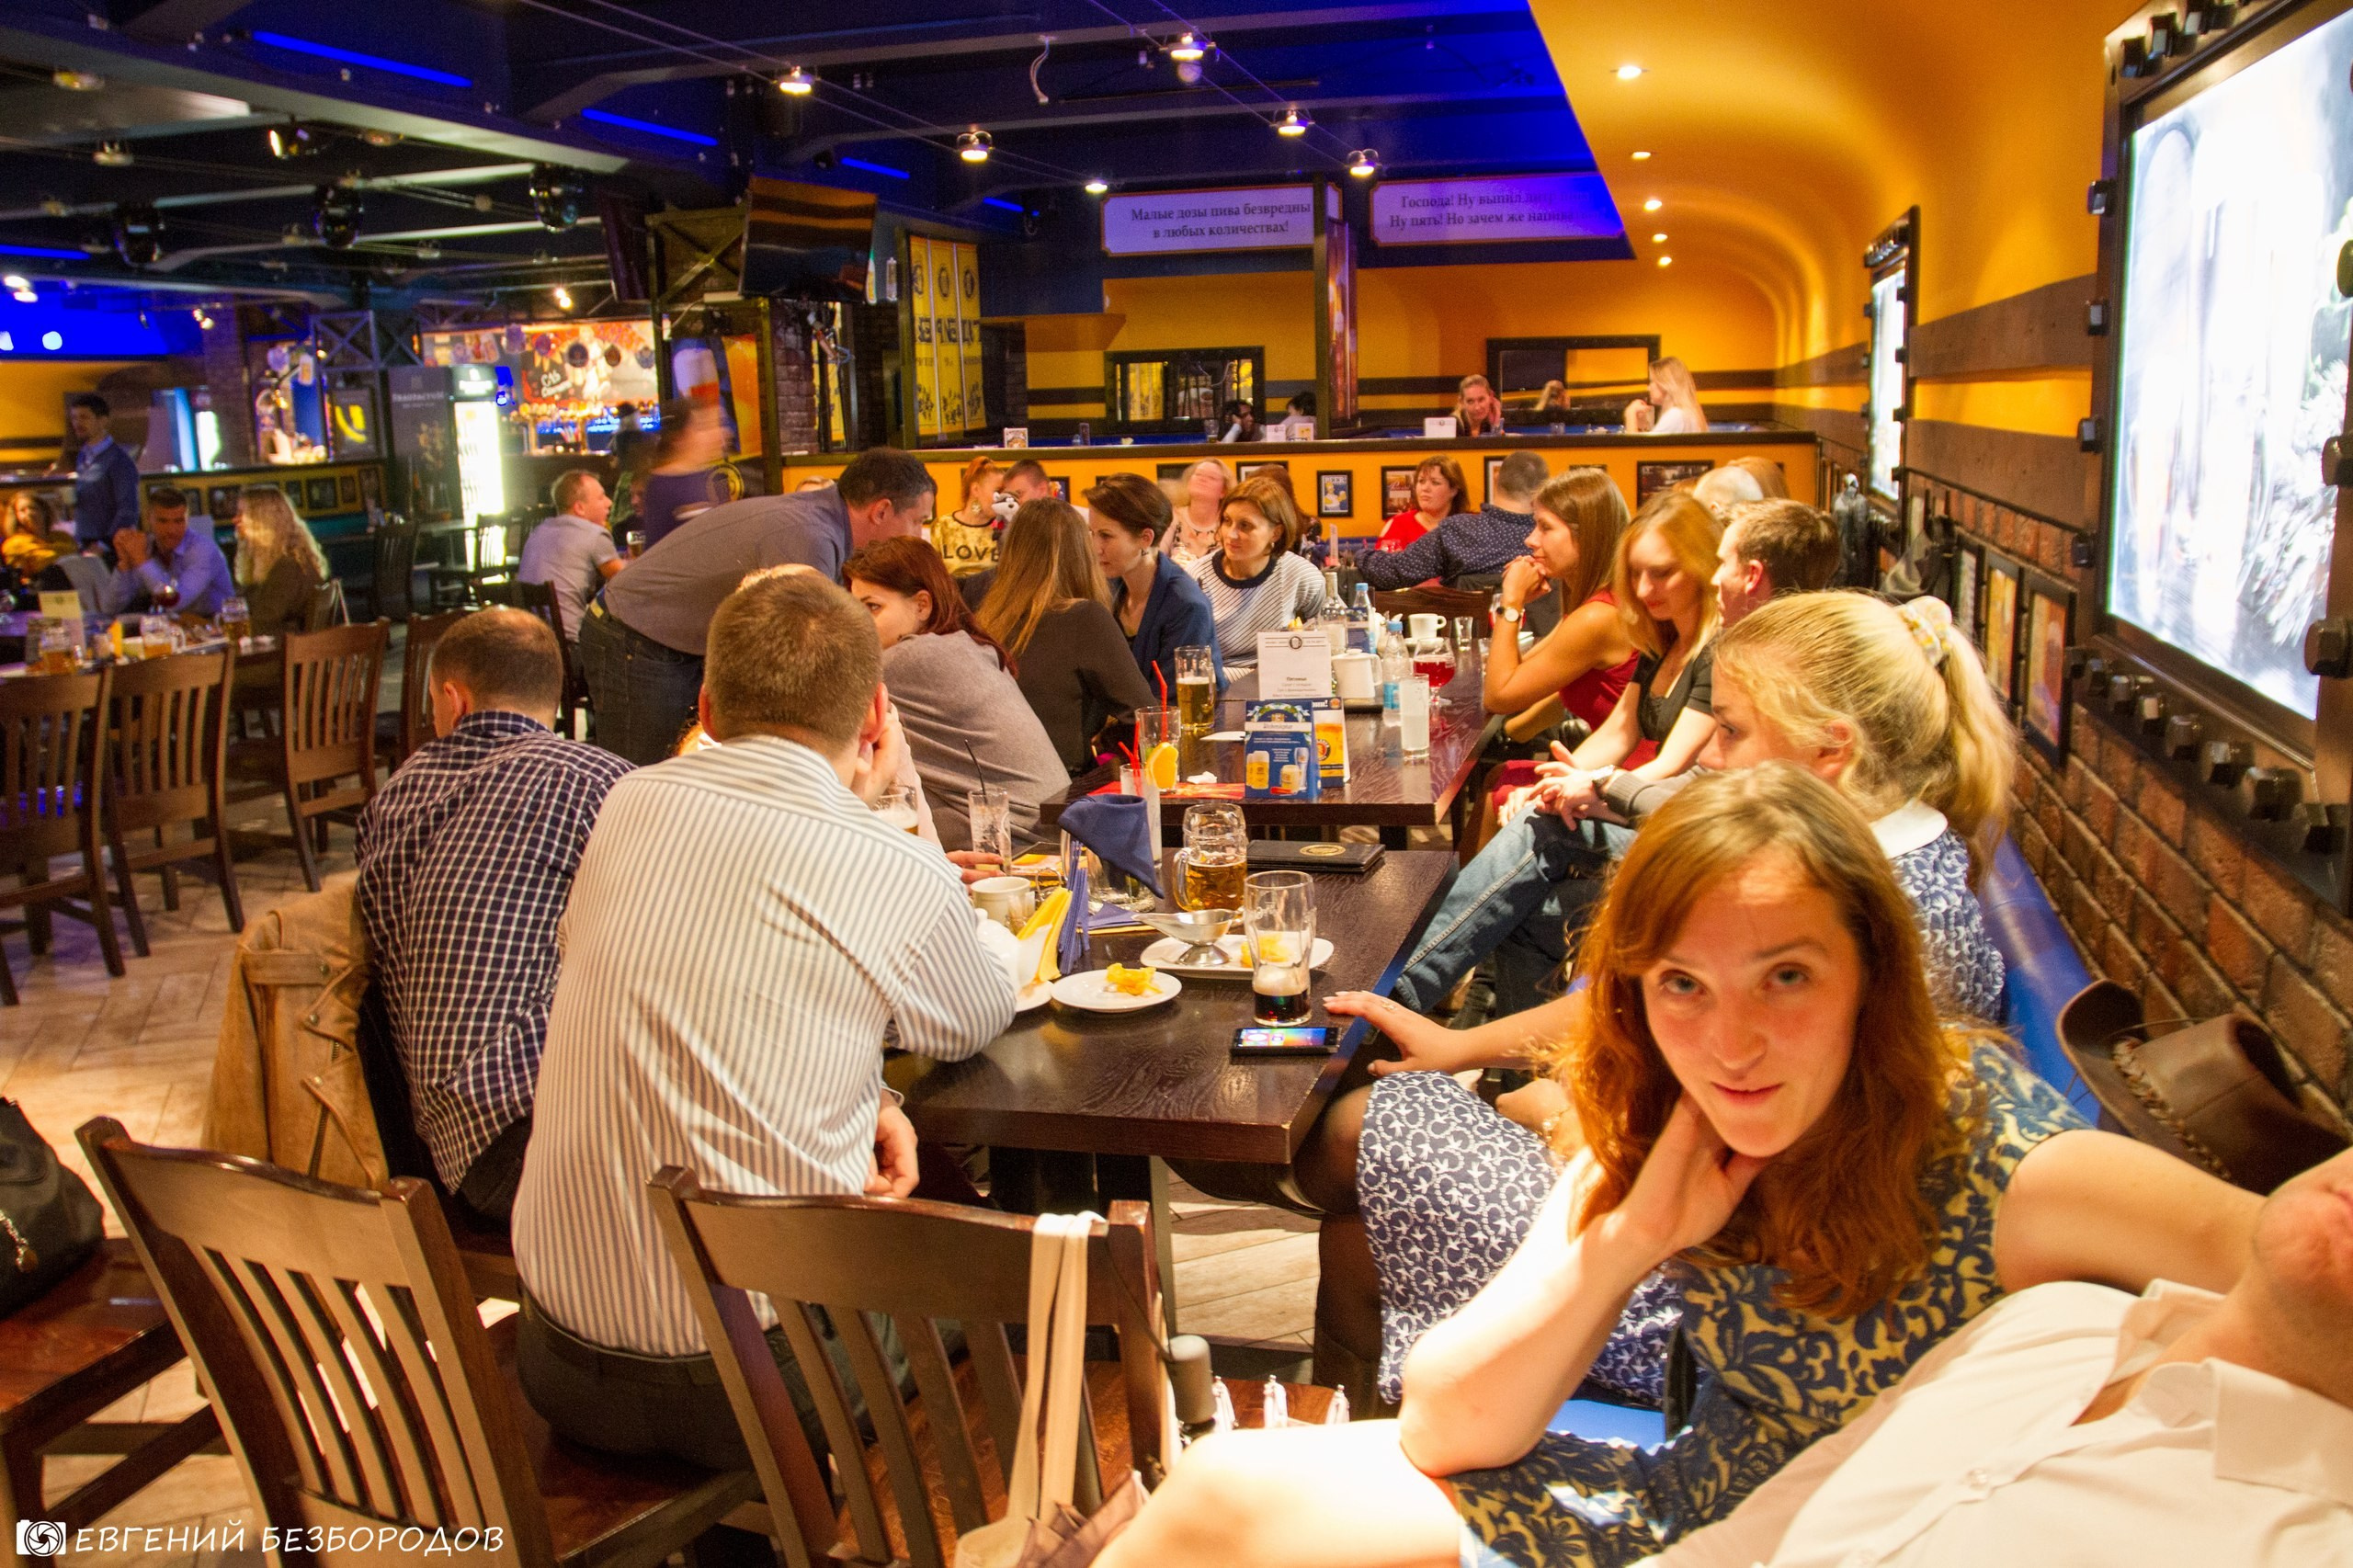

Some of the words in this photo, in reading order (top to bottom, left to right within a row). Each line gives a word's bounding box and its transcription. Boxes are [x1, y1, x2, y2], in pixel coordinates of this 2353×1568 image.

[1402, 194, 1453, 209] Господа!
[1458, 193, 1475, 209] Ну
[1131, 208, 1174, 221] Малые
[1177, 208, 1207, 220] дозы
[1211, 206, 1240, 216] пива
[1244, 202, 1311, 218] безвредны
[1153, 229, 1161, 238] в
[1164, 224, 1205, 238] любых
[1209, 220, 1289, 236] количествах!
[1390, 214, 1407, 231] Ну
[1411, 214, 1443, 227] пять!
[1447, 212, 1464, 225] Но
[1468, 213, 1504, 224] зачем
[1507, 212, 1525, 223] же
[942, 544, 999, 562] LOVE
